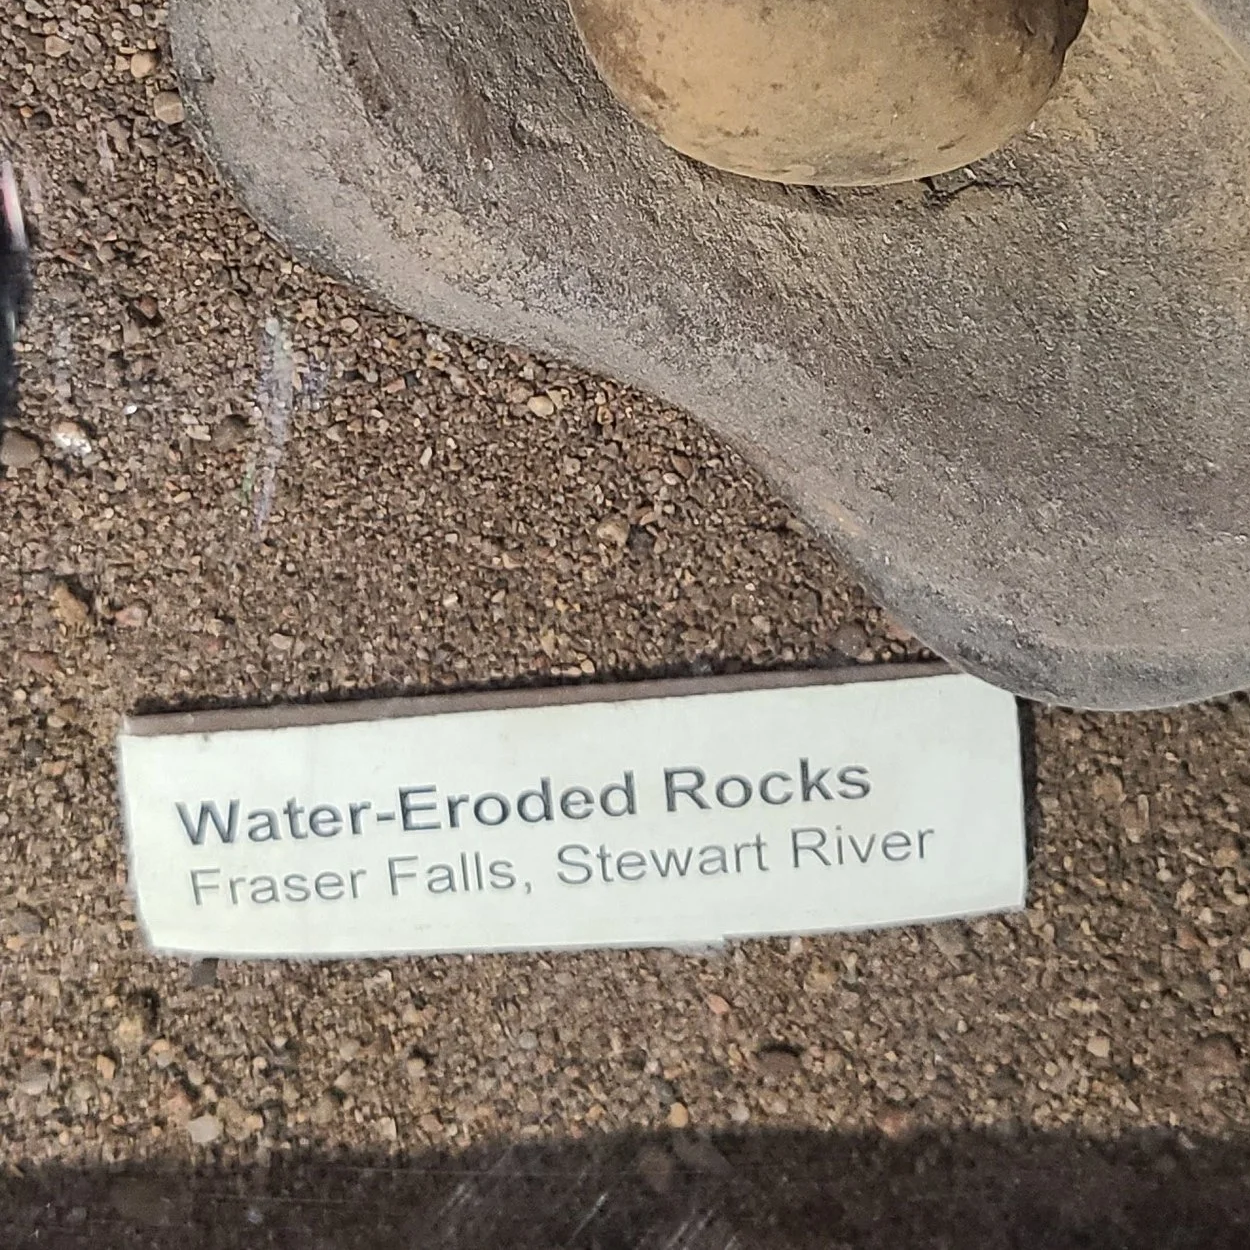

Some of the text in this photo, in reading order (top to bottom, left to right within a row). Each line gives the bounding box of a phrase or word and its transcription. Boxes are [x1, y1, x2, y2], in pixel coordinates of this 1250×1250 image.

[174, 757, 873, 847] Water-Eroded Rocks
[190, 824, 936, 906] Fraser Falls, Stewart River
